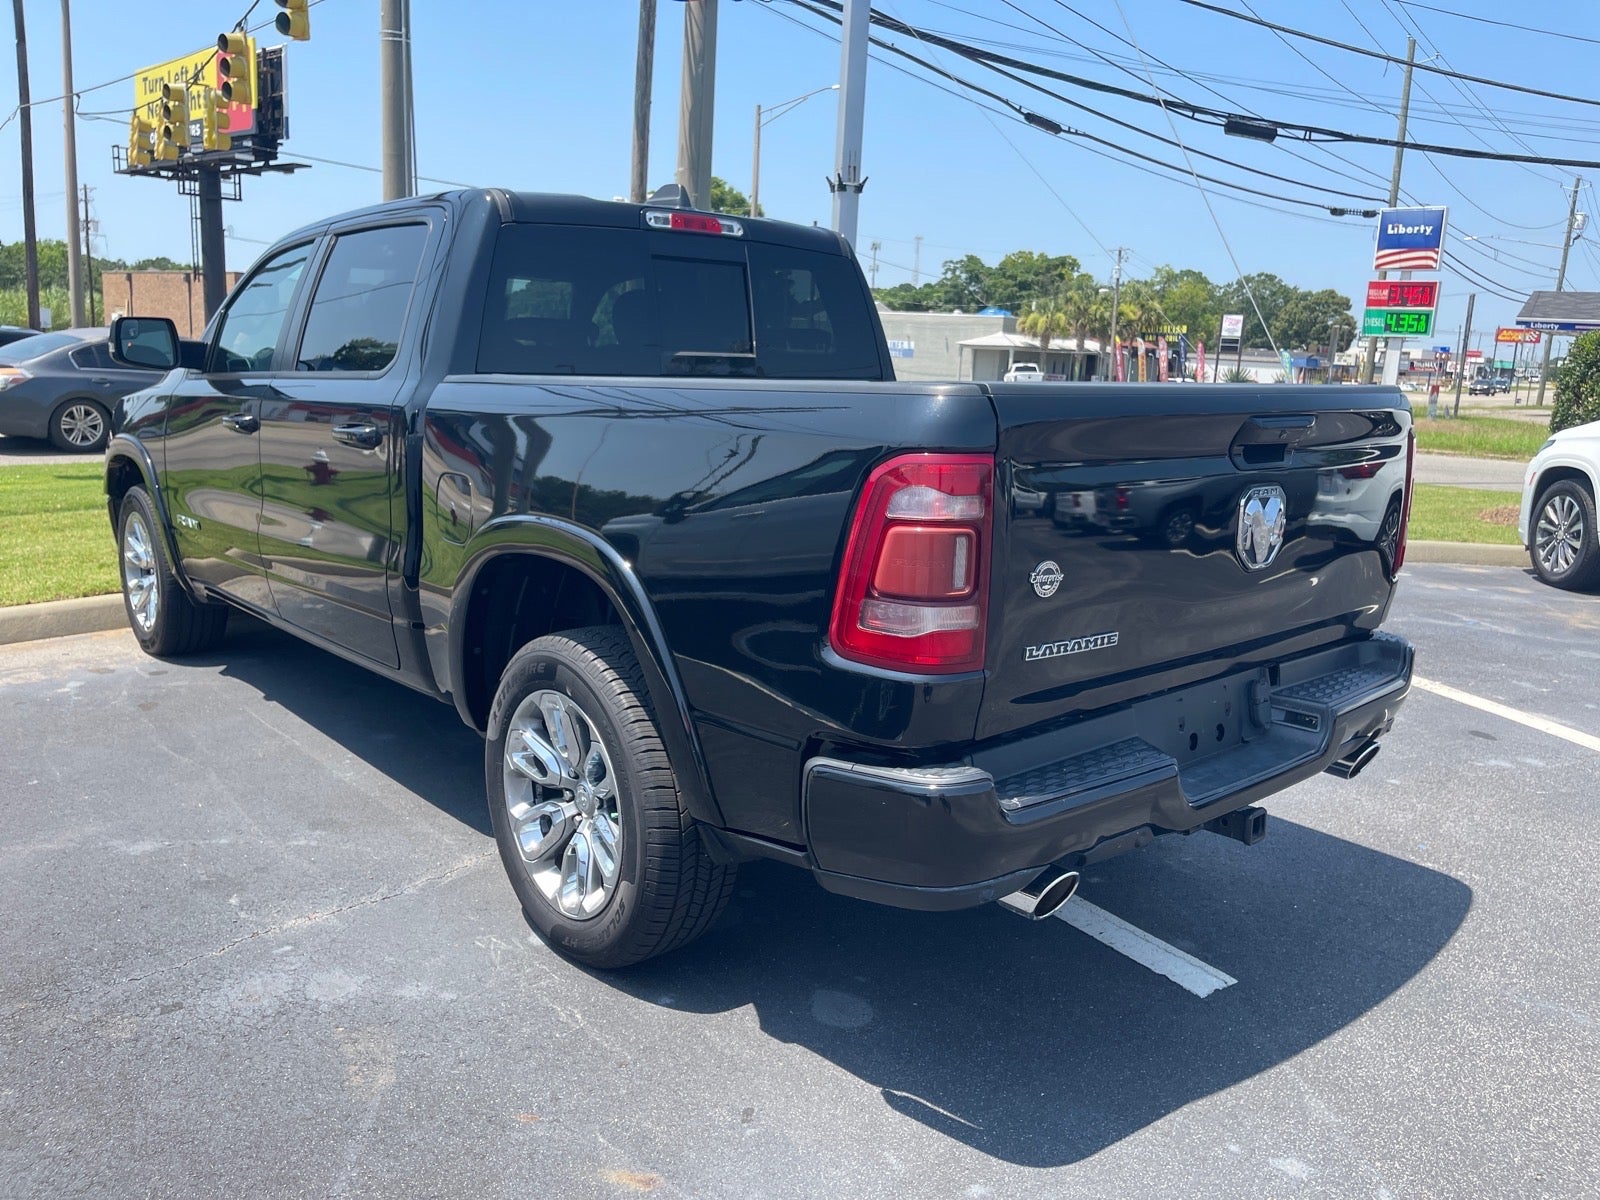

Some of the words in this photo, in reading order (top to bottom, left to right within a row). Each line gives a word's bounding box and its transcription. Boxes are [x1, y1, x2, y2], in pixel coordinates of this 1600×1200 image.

[142, 76, 164, 95] Turn
[168, 66, 189, 84] Left
[193, 62, 205, 82] At
[1387, 223, 1433, 235] Liberty
[1365, 317, 1385, 327] DIESEL
[1530, 322, 1560, 330] Liberty
[1253, 488, 1278, 497] RAM
[1029, 572, 1065, 584] Enterprise
[1025, 631, 1119, 661] LARAMIE
